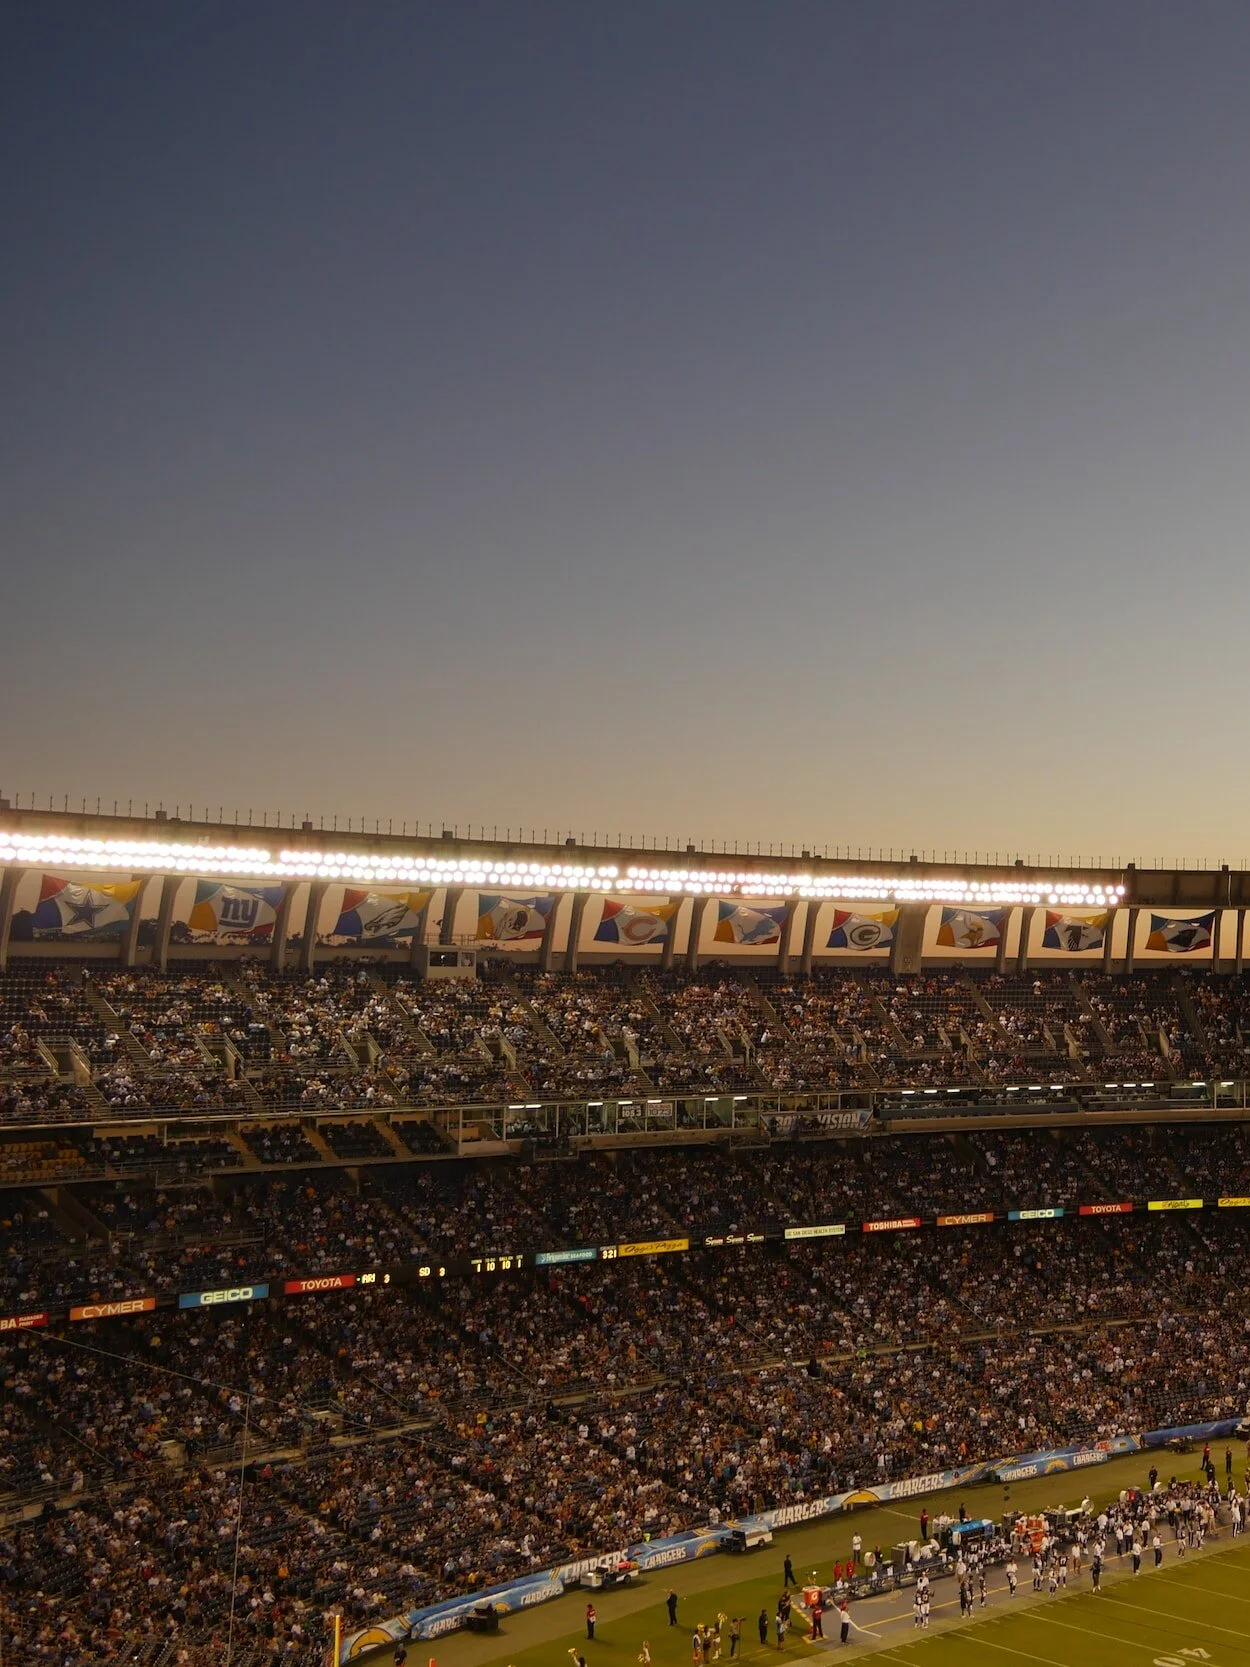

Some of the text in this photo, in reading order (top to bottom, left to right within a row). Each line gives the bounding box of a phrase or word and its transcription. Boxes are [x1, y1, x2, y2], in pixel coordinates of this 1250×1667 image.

[1020, 1209, 1056, 1219] GEICO
[1091, 1204, 1122, 1213] TOYOTA
[868, 1220, 903, 1231] TOSHIBA
[945, 1214, 988, 1225] CYMER
[419, 1266, 431, 1278] SD
[486, 1262, 496, 1272] 10
[501, 1260, 511, 1271] 10
[300, 1277, 343, 1291] TOYOTA
[200, 1286, 254, 1305] GEICO
[82, 1299, 145, 1319] CYMER
[1073, 1452, 1105, 1466] CHARGERS
[1003, 1464, 1038, 1481] CHARGERS
[889, 1471, 945, 1499] CHARGERS
[771, 1497, 831, 1527] CHARGERS
[644, 1546, 687, 1569] CHARGERS
[564, 1548, 630, 1584] CHARGERS
[1153, 1647, 1212, 1667] 40
